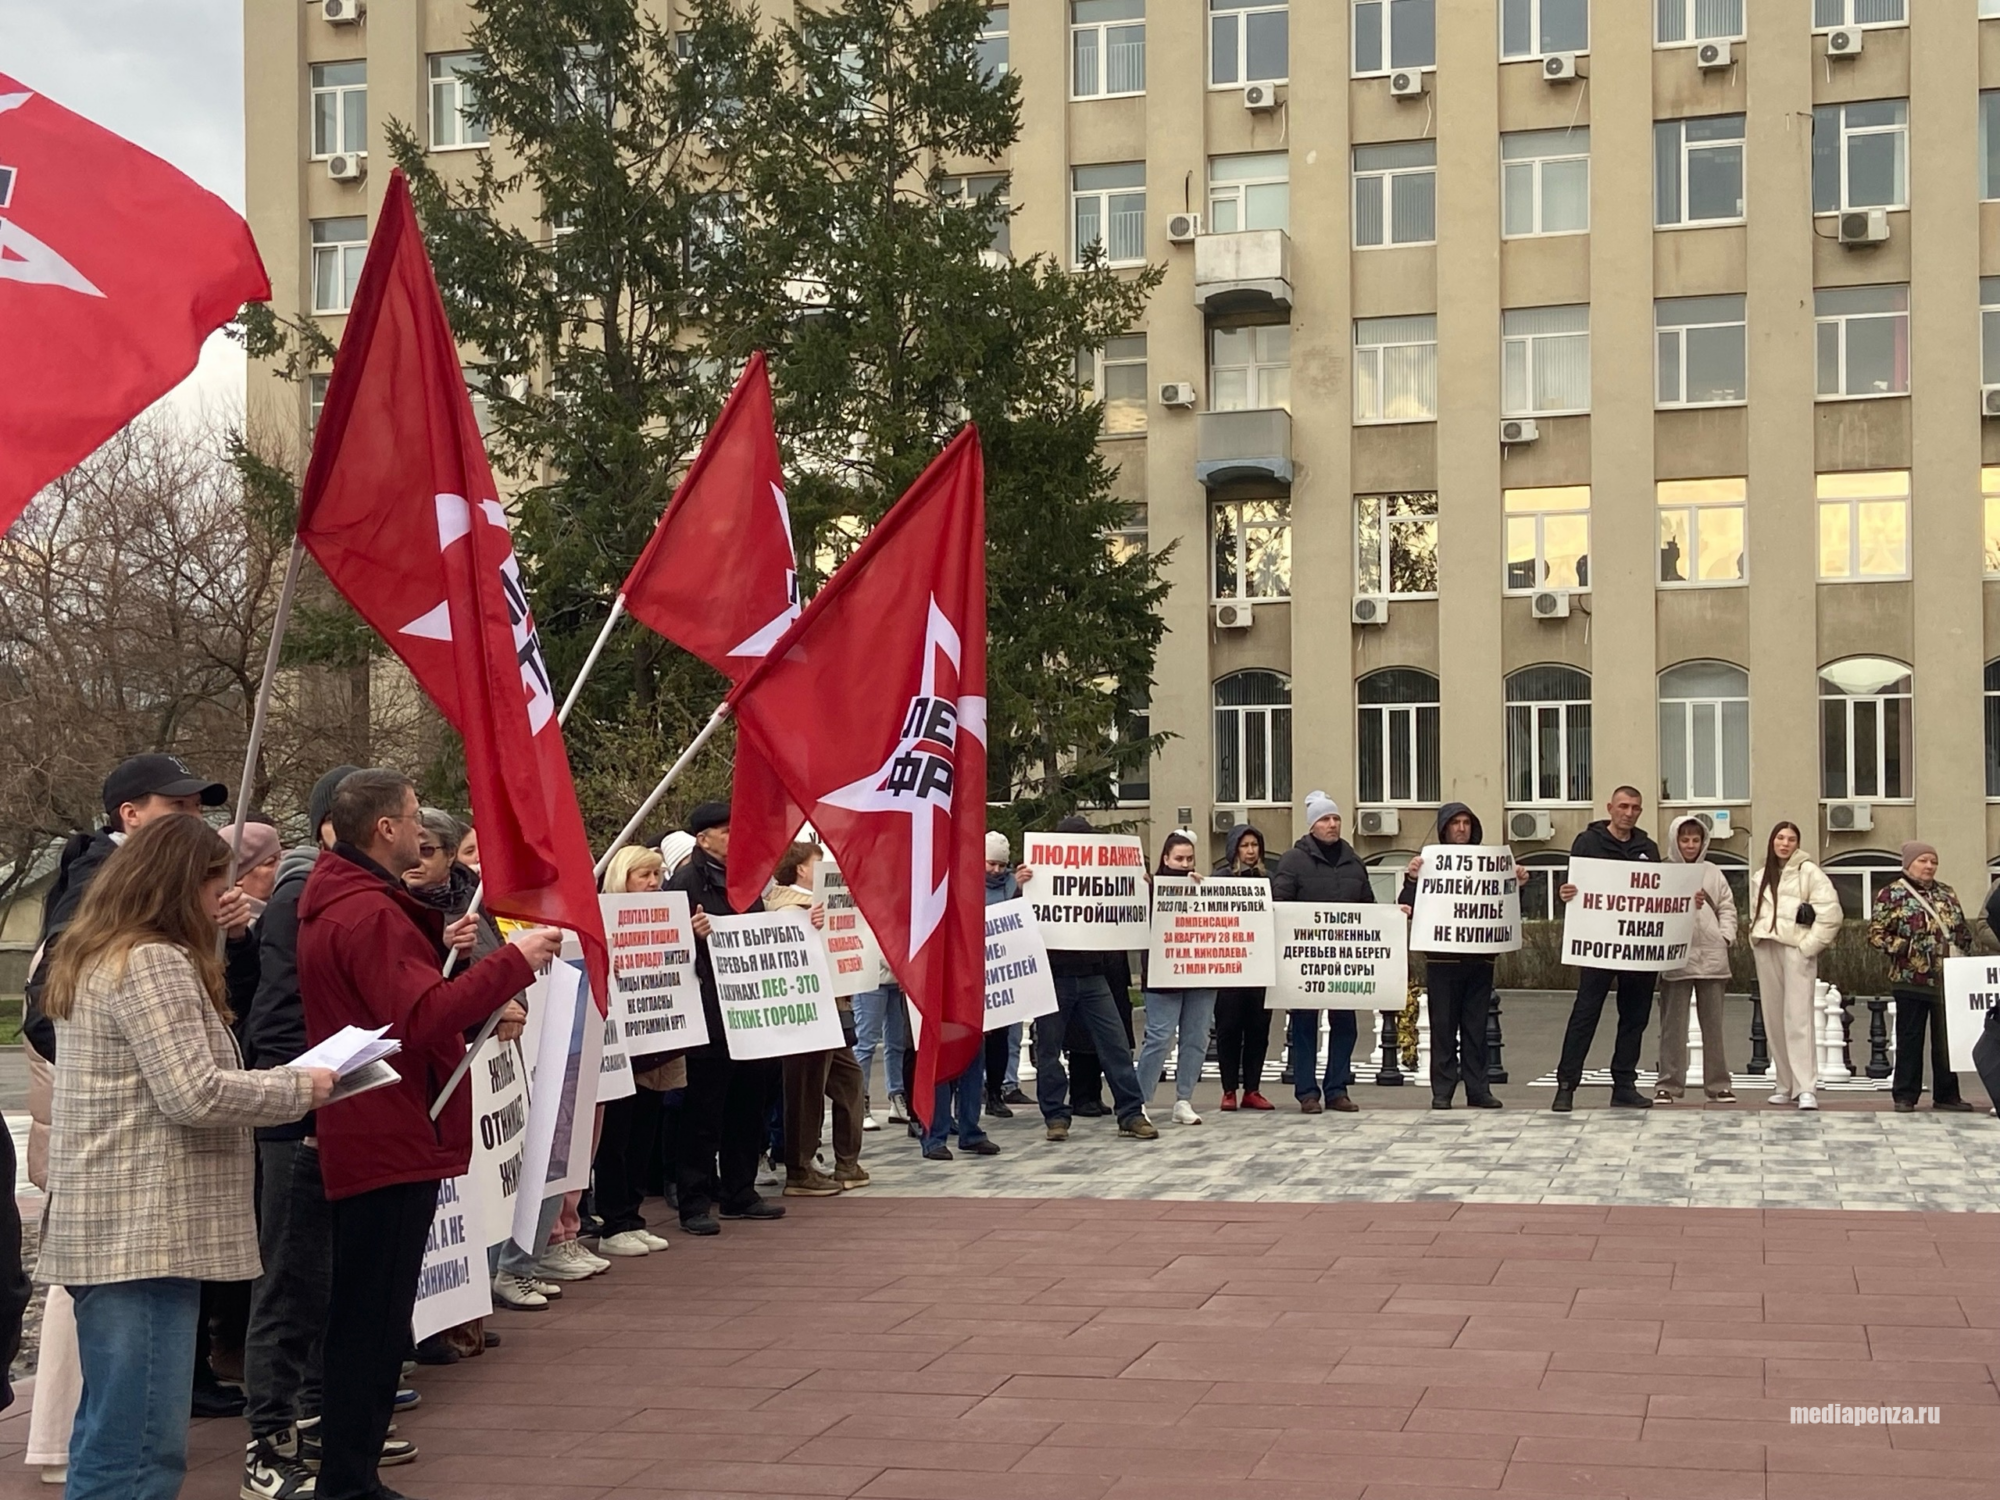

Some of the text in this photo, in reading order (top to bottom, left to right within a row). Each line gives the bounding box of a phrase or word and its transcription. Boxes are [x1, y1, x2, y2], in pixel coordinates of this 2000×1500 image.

[1030, 845, 1142, 869] ЛЮДИ ВАЖНЕЕ
[1435, 855, 1452, 871] ЗА
[1456, 855, 1473, 871] 75
[1052, 875, 1135, 896] ПРИБЫЛИ
[1630, 872, 1661, 890] НАС
[1157, 885, 1183, 897] ПРЕМИЯ
[1200, 886, 1253, 897] НИКОЛАЕВА
[1254, 886, 1266, 897] ЗА
[1157, 901, 1173, 912] 2023
[1174, 901, 1188, 914] ГОД
[1208, 901, 1229, 912] МЛН
[1453, 900, 1504, 920] ЖИЛЬЁ
[1583, 893, 1691, 914] НЕ УСТРАИВАЕТ
[1032, 902, 1147, 926] ЗАСТРОЙЩИКОВ!
[1175, 916, 1240, 928] КОМПЕНСАЦИЯ
[1314, 911, 1361, 925] 5 ТЫСЯЧ
[742, 925, 805, 947] ВЫРУБАТЬ
[1164, 932, 1173, 943] ЗА
[1174, 932, 1217, 943] КВАРТИРУ
[1219, 932, 1231, 943] 28
[1294, 928, 1381, 942] УНИЧТОЖЕННЫХ
[1434, 925, 1452, 942] НЕ
[1618, 919, 1664, 938] ТАКАЯ
[1165, 948, 1174, 959] ОТ
[1194, 947, 1248, 959] НИКОЛАЕВА
[1283, 946, 1391, 960] ДЕРЕВЬЕВ НА БЕРЕГУ
[1571, 939, 1688, 961] ПРОГРАММА КРТ!
[716, 949, 809, 975] ДЕРЕВЬЯ НА ГПЗ И
[1186, 963, 1207, 975] МЛН
[1208, 961, 1242, 975] РУБЛЕЙ
[1301, 961, 1375, 976] СТАРОЙ СУРЫ
[762, 977, 788, 999] ЛЕС
[796, 974, 820, 994] ЭТО
[1304, 981, 1325, 993] ЭТО
[1327, 981, 1376, 995] ЭКОЦИД!
[627, 993, 673, 1014] НЕ СОГЛАСНЫ
[764, 1002, 818, 1027] ГОРОДА!
[625, 1014, 670, 1037] ПРОГРАММОЙ
[441, 1219, 449, 1248] А
[449, 1215, 466, 1245] НЕ
